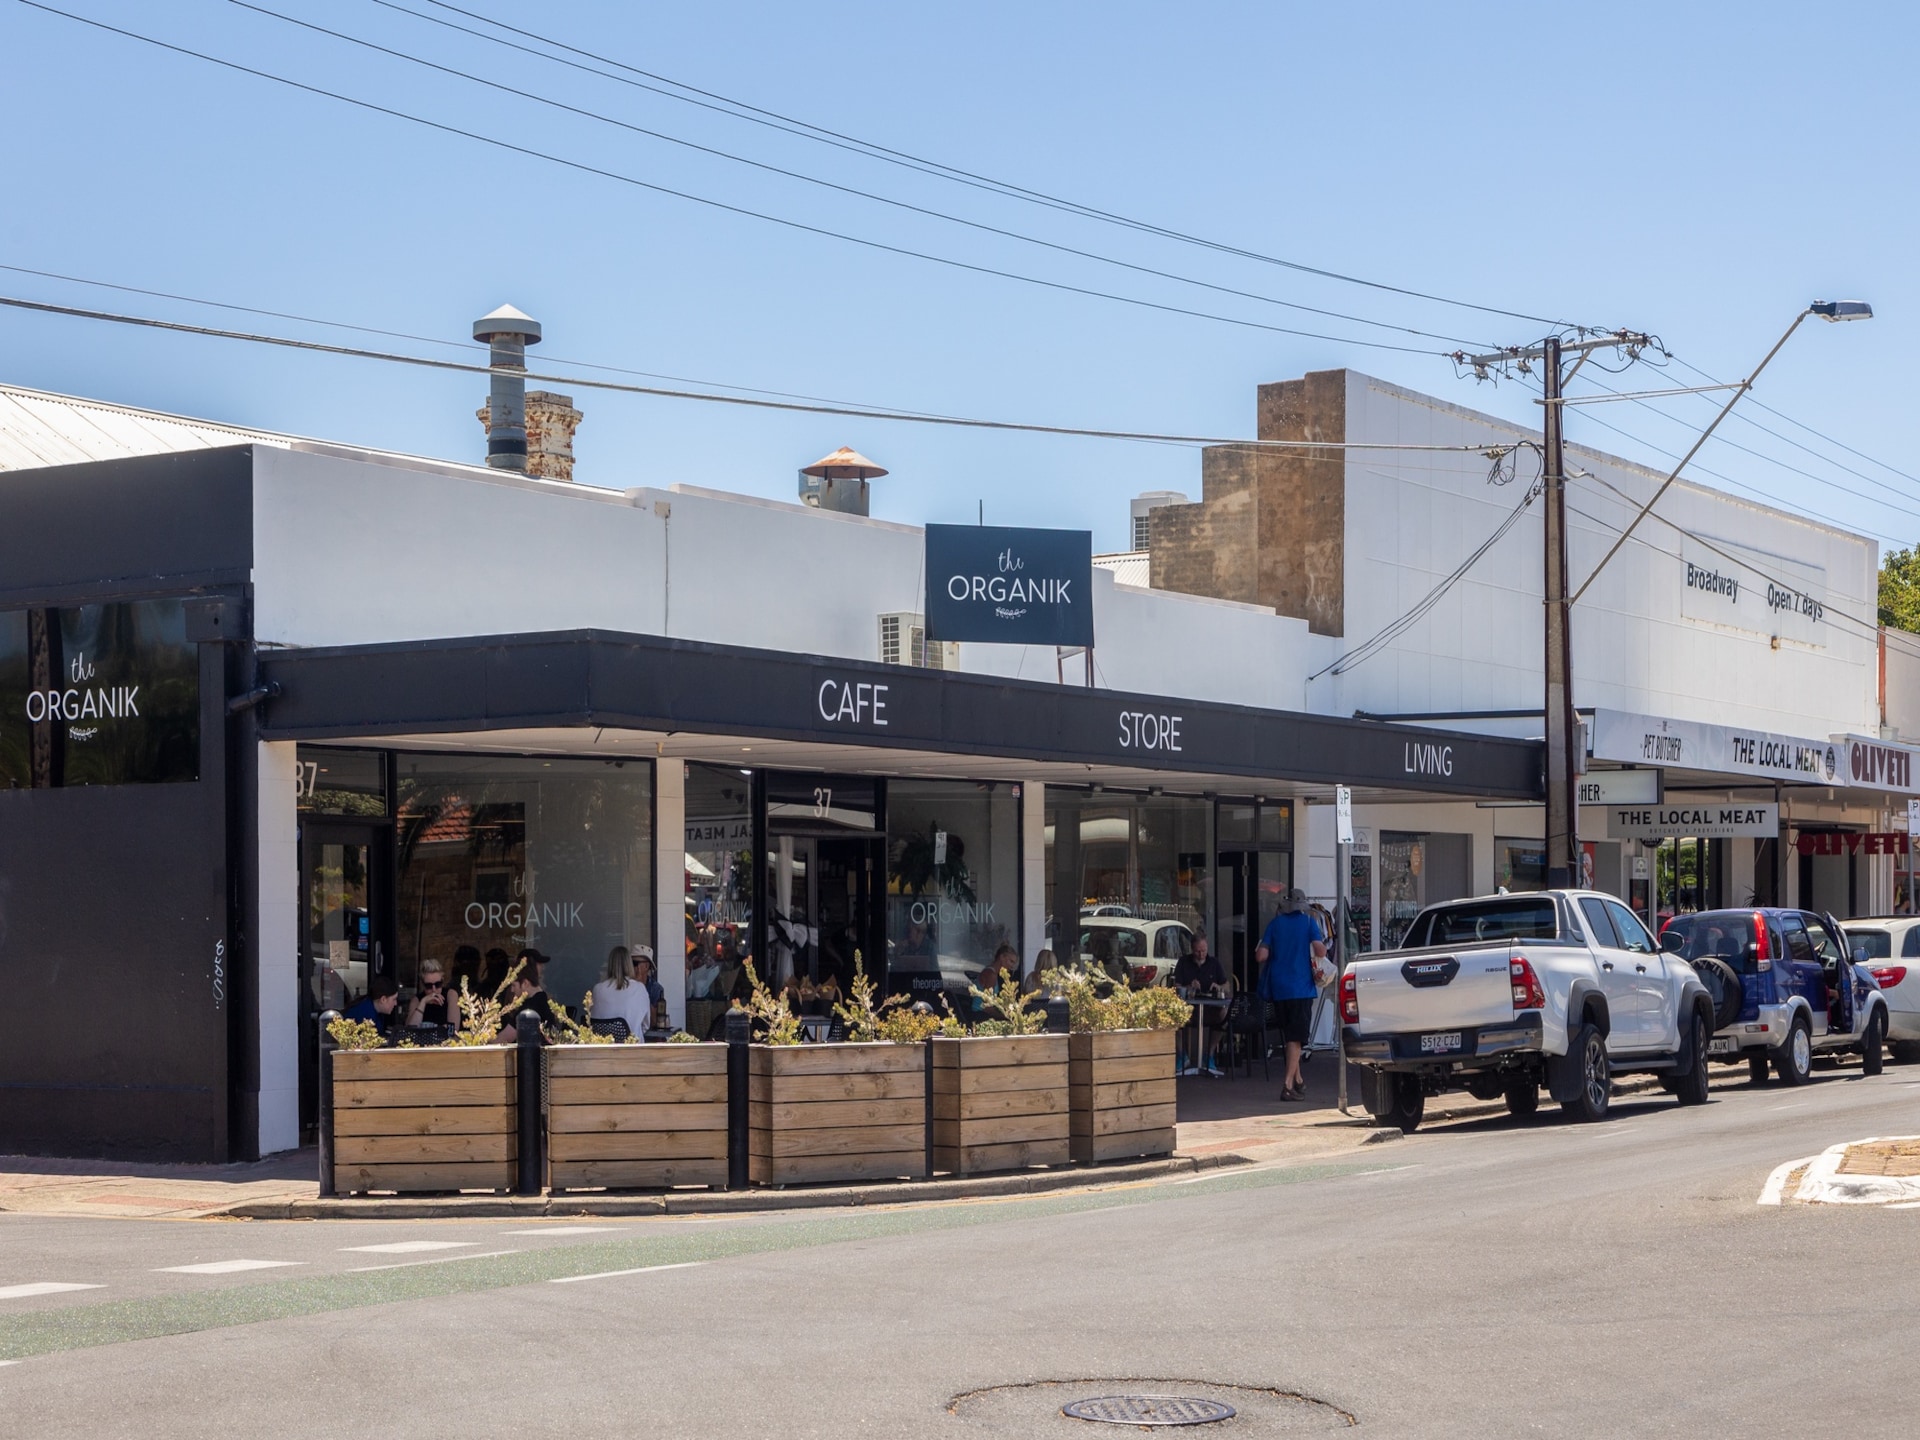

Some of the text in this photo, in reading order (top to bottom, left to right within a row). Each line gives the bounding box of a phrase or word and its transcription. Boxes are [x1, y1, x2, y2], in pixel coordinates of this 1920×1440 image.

[998, 548, 1024, 572] the
[948, 575, 1072, 604] ORGANIK
[1687, 563, 1738, 603] Broadway
[1767, 583, 1823, 622] Open 7 days
[71, 652, 95, 683] the
[26, 686, 139, 721] ORGANIK
[819, 679, 888, 725] CAFE
[1119, 711, 1182, 751] STORE
[1405, 742, 1452, 776] LIVING
[1643, 734, 1681, 762] PET BUTCHER
[1733, 737, 1755, 764] THE
[1759, 741, 1792, 769] LOCAL
[1795, 746, 1822, 773] MEAT
[1851, 742, 1910, 787] OLIVETI
[814, 787, 832, 818] 37
[1618, 810, 1766, 825] THE LOCAL MEAT
[1796, 832, 1909, 855] OLIVETI
[465, 902, 584, 929] ORGANIK
[910, 902, 996, 924] ORGANIK
[1422, 1037, 1441, 1048] S512
